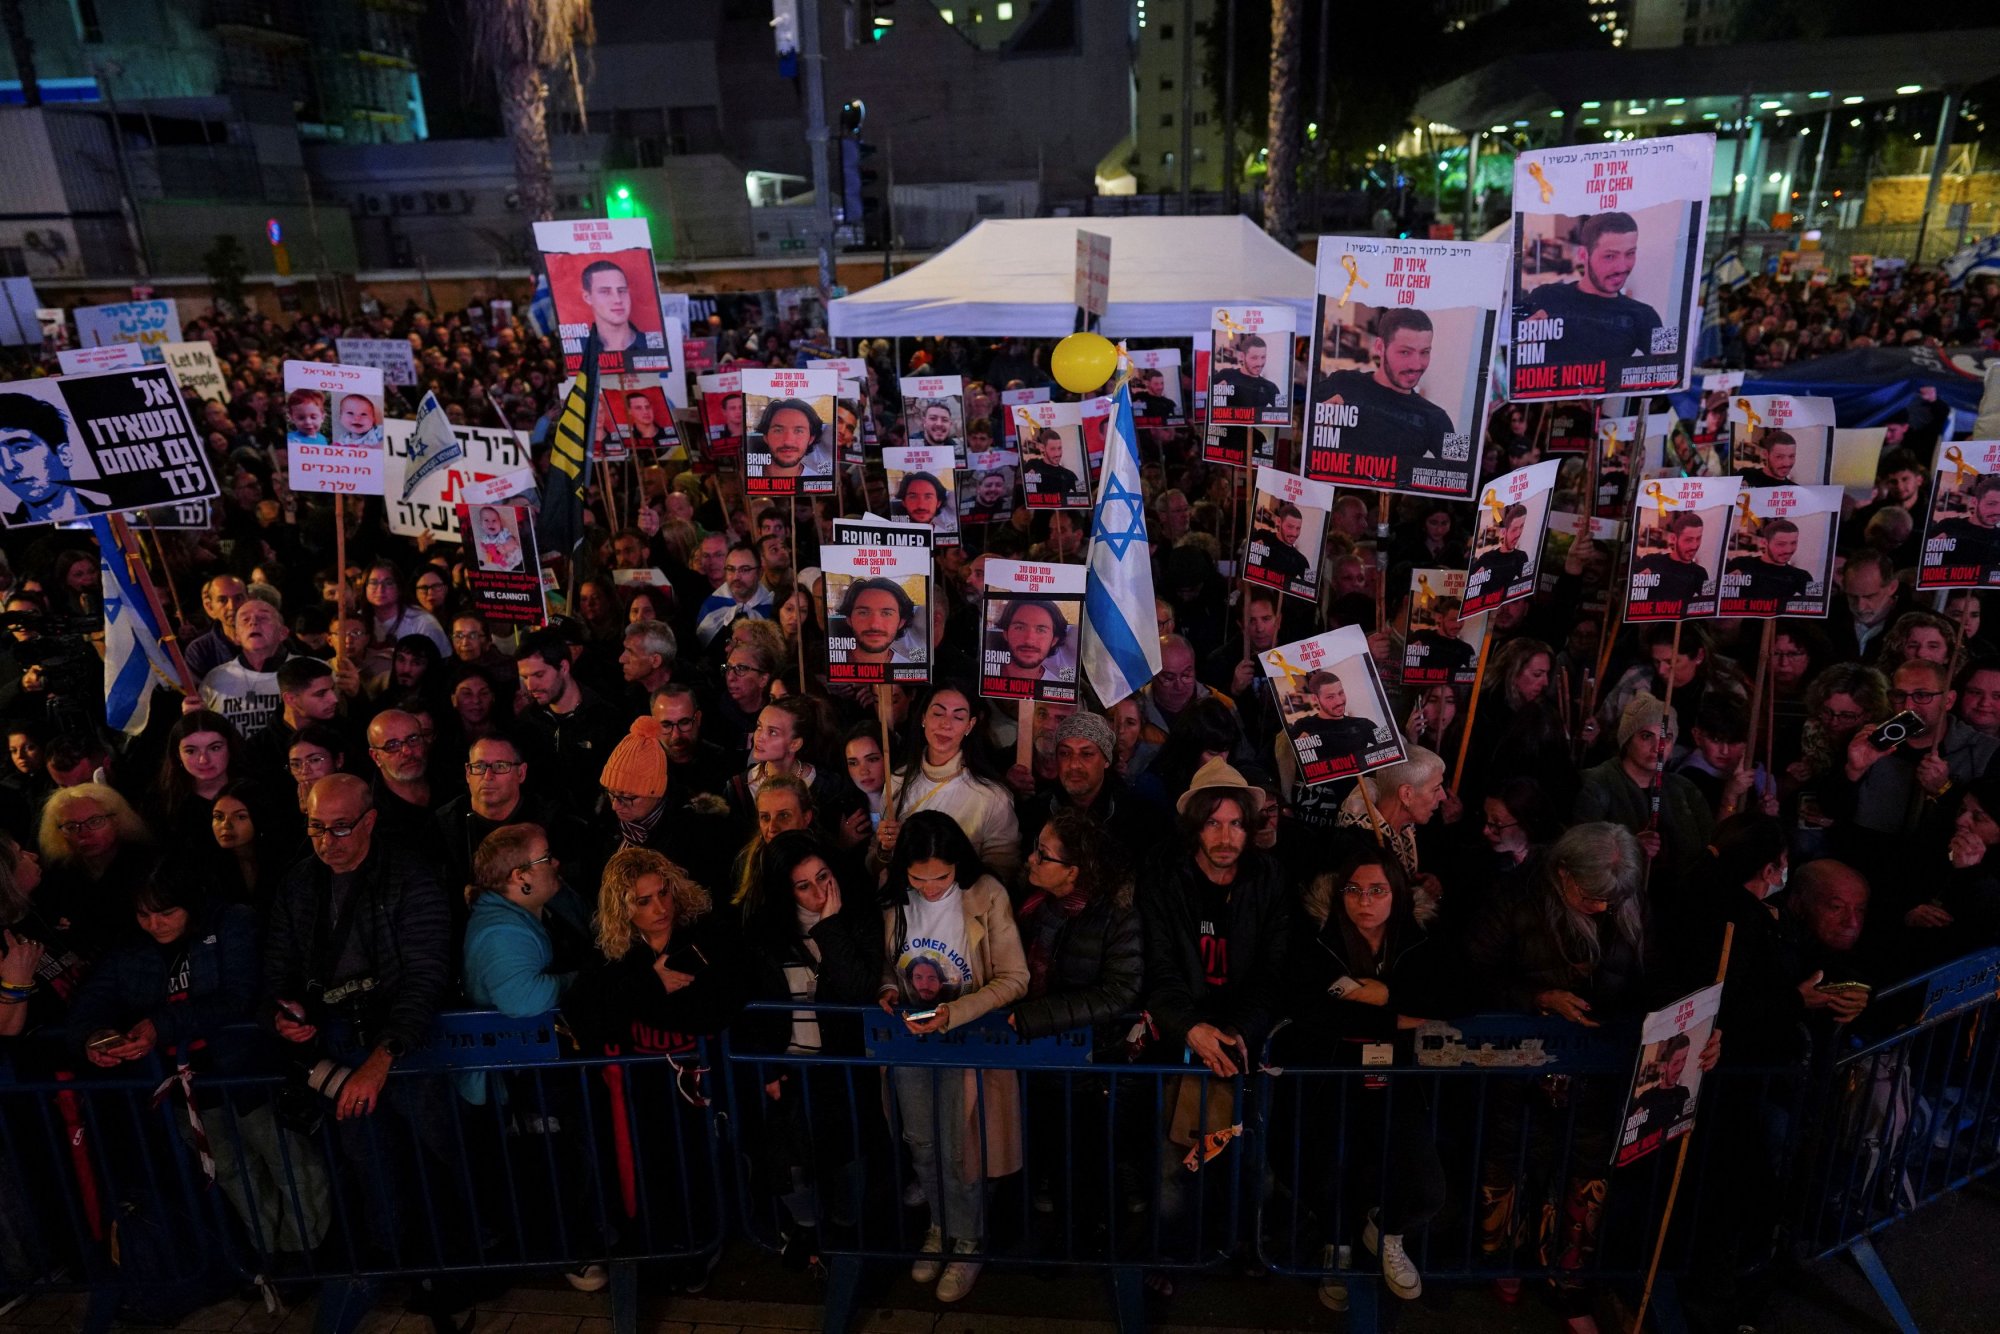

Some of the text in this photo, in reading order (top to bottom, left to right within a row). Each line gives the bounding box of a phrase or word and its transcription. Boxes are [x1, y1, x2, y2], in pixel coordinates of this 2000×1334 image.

[1550, 144, 1674, 165] חייב לחזור הביתה, עכשיו
[1593, 161, 1628, 179] איתי חן
[1586, 176, 1634, 194] ITAY CHEN
[1599, 194, 1617, 210] (19)
[1381, 244, 1471, 257] חייב לחזור הביתה,
[1394, 257, 1427, 273] איתי חן
[1386, 273, 1431, 289] ITAY CHEN
[1397, 290, 1415, 306] (19)
[559, 323, 590, 338] BRING
[1517, 317, 1564, 342] BRING
[561, 339, 583, 354] HIM
[171, 353, 189, 368] Let
[194, 351, 212, 367] My
[1516, 342, 1546, 366] HIM
[180, 372, 219, 390] People
[1515, 360, 1607, 390] HOME NOW!
[1621, 371, 1678, 385] FAMILIES FORUM
[785, 380, 799, 388] SHEM
[800, 380, 809, 388] TOV
[1213, 384, 1235, 396] BRING
[131, 376, 173, 407] אל
[1213, 396, 1227, 407] HIM
[1213, 407, 1232, 419] HOME
[1234, 406, 1255, 419] NOW!
[1315, 402, 1359, 428] BRING
[1768, 409, 1792, 417] ITAY CHEN
[86, 407, 185, 446] תשאירו
[1208, 426, 1228, 438] BRING
[1207, 435, 1220, 446] HIM
[1313, 426, 1341, 449] HIM
[96, 437, 198, 475] גם אותם
[300, 445, 368, 459] מה אם הם
[747, 453, 772, 465] BRING
[1206, 445, 1244, 461] HOME NOW!
[1983, 454, 1996, 463] ITAY
[302, 462, 372, 476] היו הנכדים
[747, 465, 763, 477] HIM
[1311, 450, 1398, 480] HOME NOW!
[160, 463, 207, 495] לבד
[747, 477, 796, 490] HOME NOW!
[1025, 473, 1042, 483] BRING
[1411, 474, 1468, 490] FAMILIES FORUM
[1026, 483, 1038, 493] HIM
[1509, 481, 1529, 494] ITAY CHEN
[1678, 491, 1704, 499] ITAY CHEN
[1767, 499, 1797, 507] ITAY CHEN
[174, 505, 205, 524] לבד
[842, 529, 881, 545] BRING
[886, 531, 925, 548] OMER
[1926, 538, 1957, 552] BRING
[1250, 542, 1270, 557] BRING
[853, 558, 897, 566] OMER SHEM TOV
[1248, 553, 1262, 565] HIM
[1923, 552, 1943, 566] HIM
[870, 566, 881, 576] (21)
[1247, 565, 1266, 579] HOME
[1469, 569, 1492, 587] BRING
[1922, 565, 1981, 582] HOME NOW!
[1014, 574, 1055, 584] OMER SHEM TOV
[1632, 573, 1660, 587] BRING
[1723, 573, 1752, 586] BRING
[483, 591, 530, 602] WE CANNOT!
[1466, 585, 1482, 600] HIM
[1630, 587, 1649, 600] HIM
[1721, 586, 1740, 598] HIM
[1629, 601, 1655, 615] HOME
[1655, 599, 1682, 614] NOW!
[1720, 599, 1747, 612] HOME
[1749, 598, 1778, 612] NOW!
[829, 637, 857, 650] BRING
[1406, 644, 1430, 657] BRING
[829, 650, 847, 663] HIM
[984, 650, 1011, 664] BRING
[1300, 648, 1326, 662] ITAY CHEN
[1405, 656, 1421, 667] HIM
[829, 664, 884, 678] HOME NOW!
[984, 663, 1001, 676] HIM
[1404, 668, 1449, 680] HOME NOW!
[984, 677, 1035, 694] HOME NOW!
[223, 697, 242, 714] את
[1294, 734, 1323, 751] BRING
[1299, 748, 1318, 764] HIM
[1304, 753, 1358, 778] HOME NOW!
[912, 937, 947, 952] OMER
[947, 949, 973, 982] HOME
[1626, 1109, 1650, 1130] BRING
[1622, 1127, 1639, 1146] HIM
